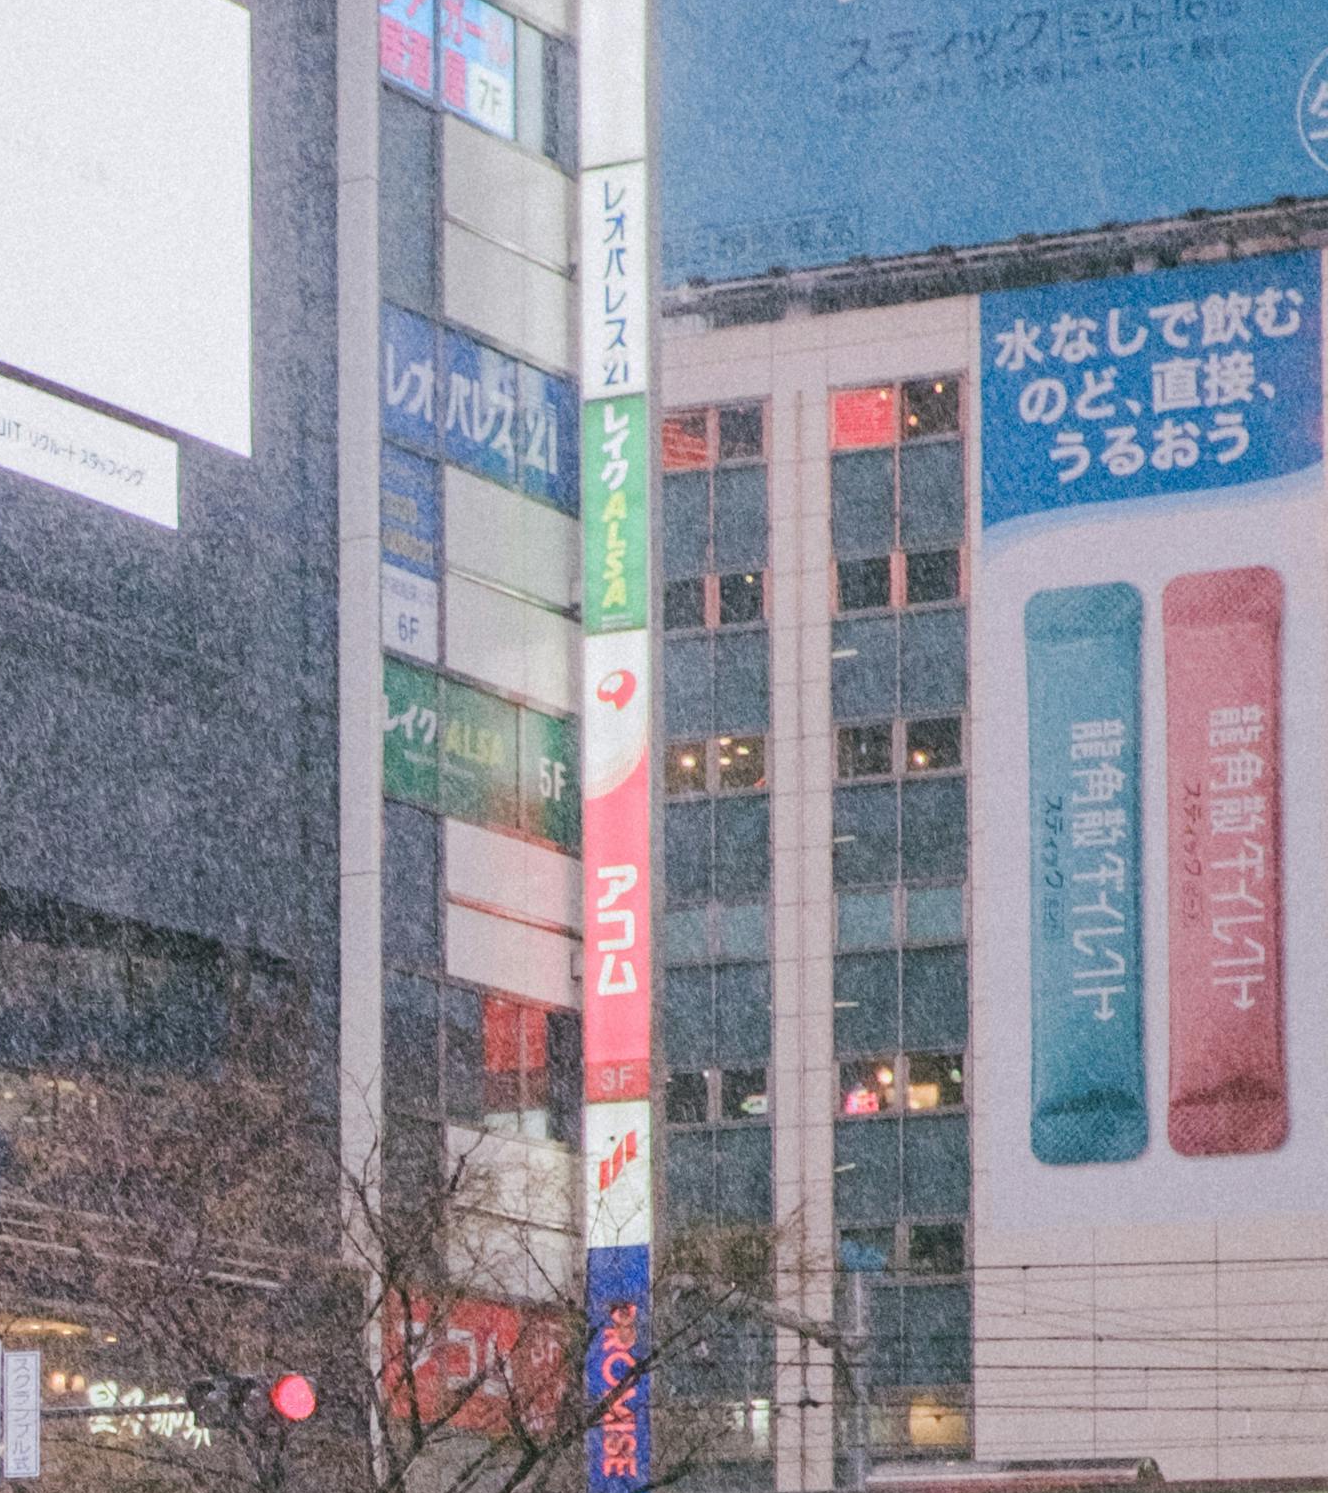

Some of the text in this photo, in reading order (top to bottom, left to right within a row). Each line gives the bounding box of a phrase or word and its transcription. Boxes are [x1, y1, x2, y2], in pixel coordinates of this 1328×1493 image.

[603, 180, 629, 386] レオパレス21
[995, 286, 1303, 372] 水なしで飲む
[386, 342, 559, 475] レオパレス21
[1018, 349, 1276, 425] のど、直接、
[600, 403, 630, 491] レイク
[1049, 412, 1250, 484] うるおう
[600, 490, 627, 608] ALSA
[397, 612, 420, 644] 6F
[597, 864, 638, 996] アコム
